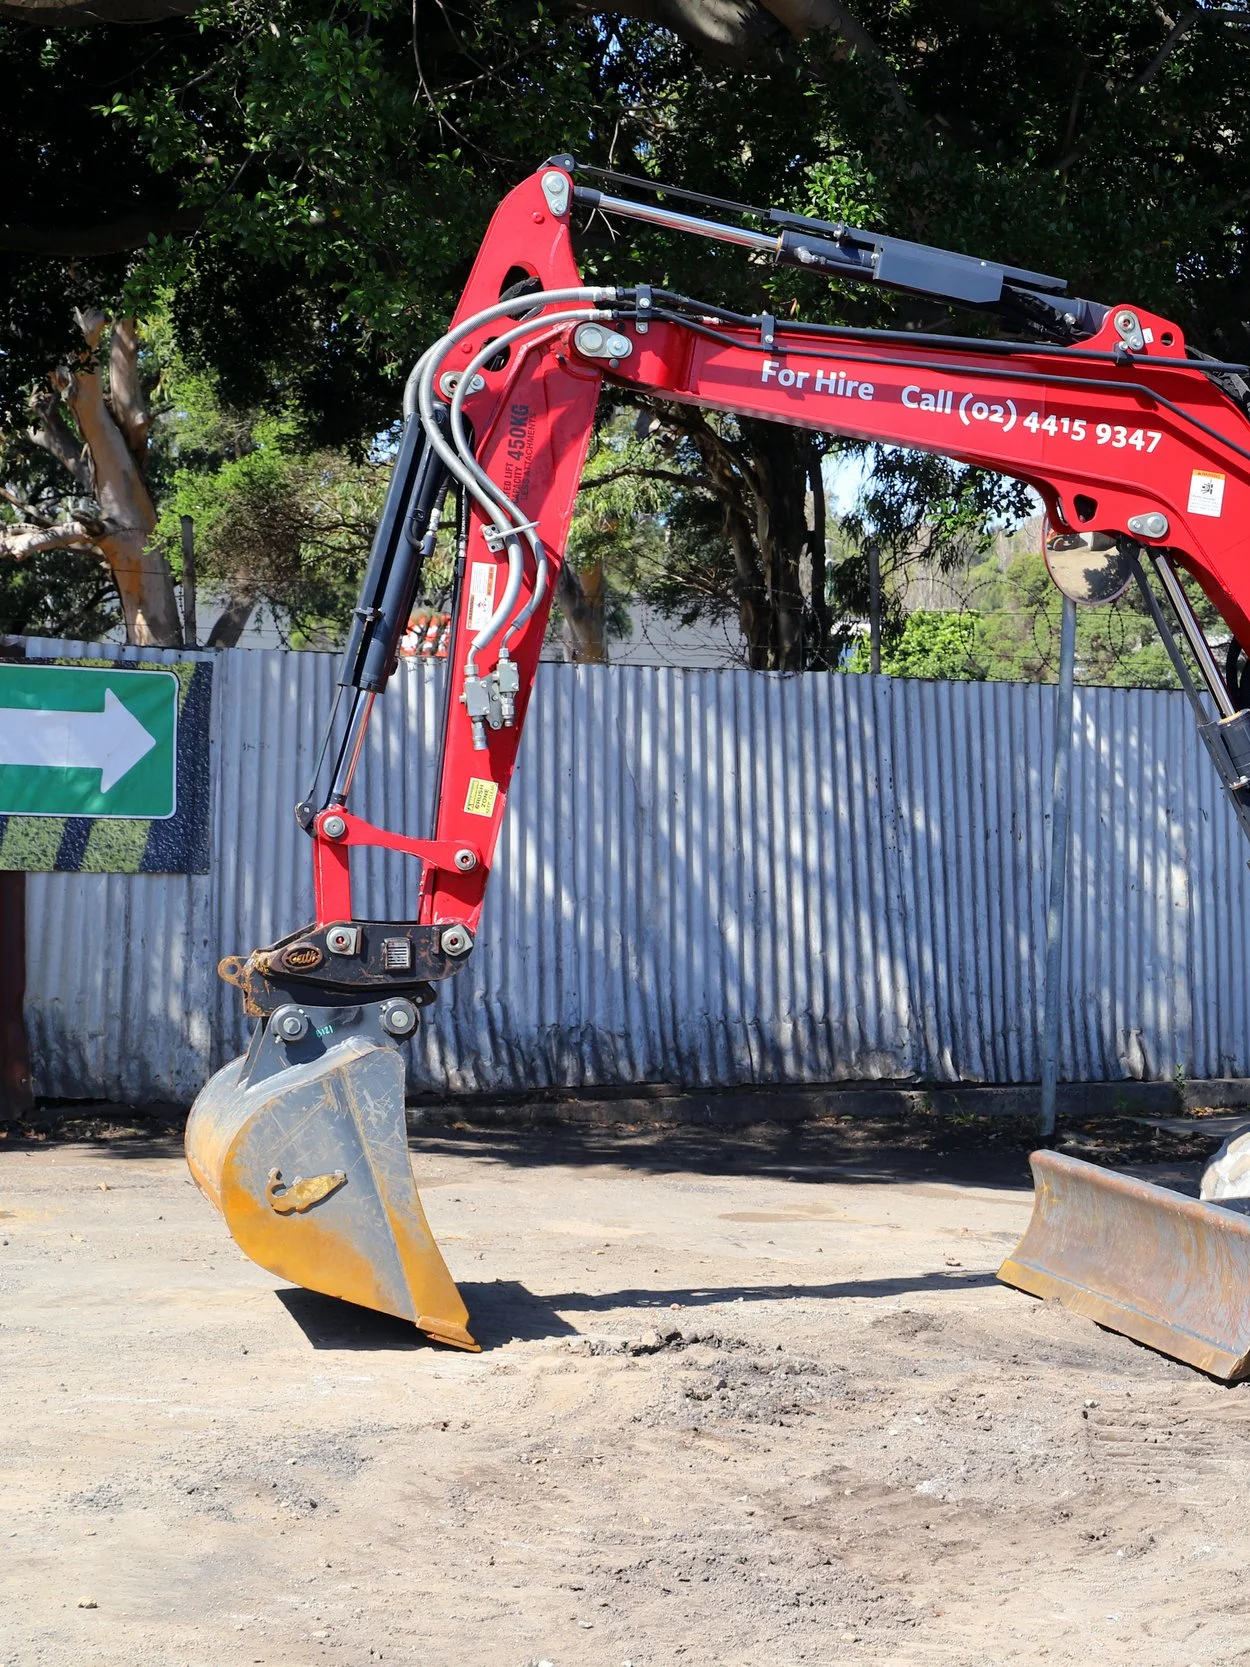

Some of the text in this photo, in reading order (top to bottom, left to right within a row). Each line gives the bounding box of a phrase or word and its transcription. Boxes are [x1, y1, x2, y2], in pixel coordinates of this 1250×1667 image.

[761, 359, 1162, 453] For Hire Call (02) 4415 9347
[507, 404, 529, 504] CAPACITY 450KG
[523, 413, 537, 478] ATTACHMENTS
[504, 462, 514, 479] LIFT
[475, 784, 484, 809] CRUSH
[481, 788, 490, 808] ZONE
